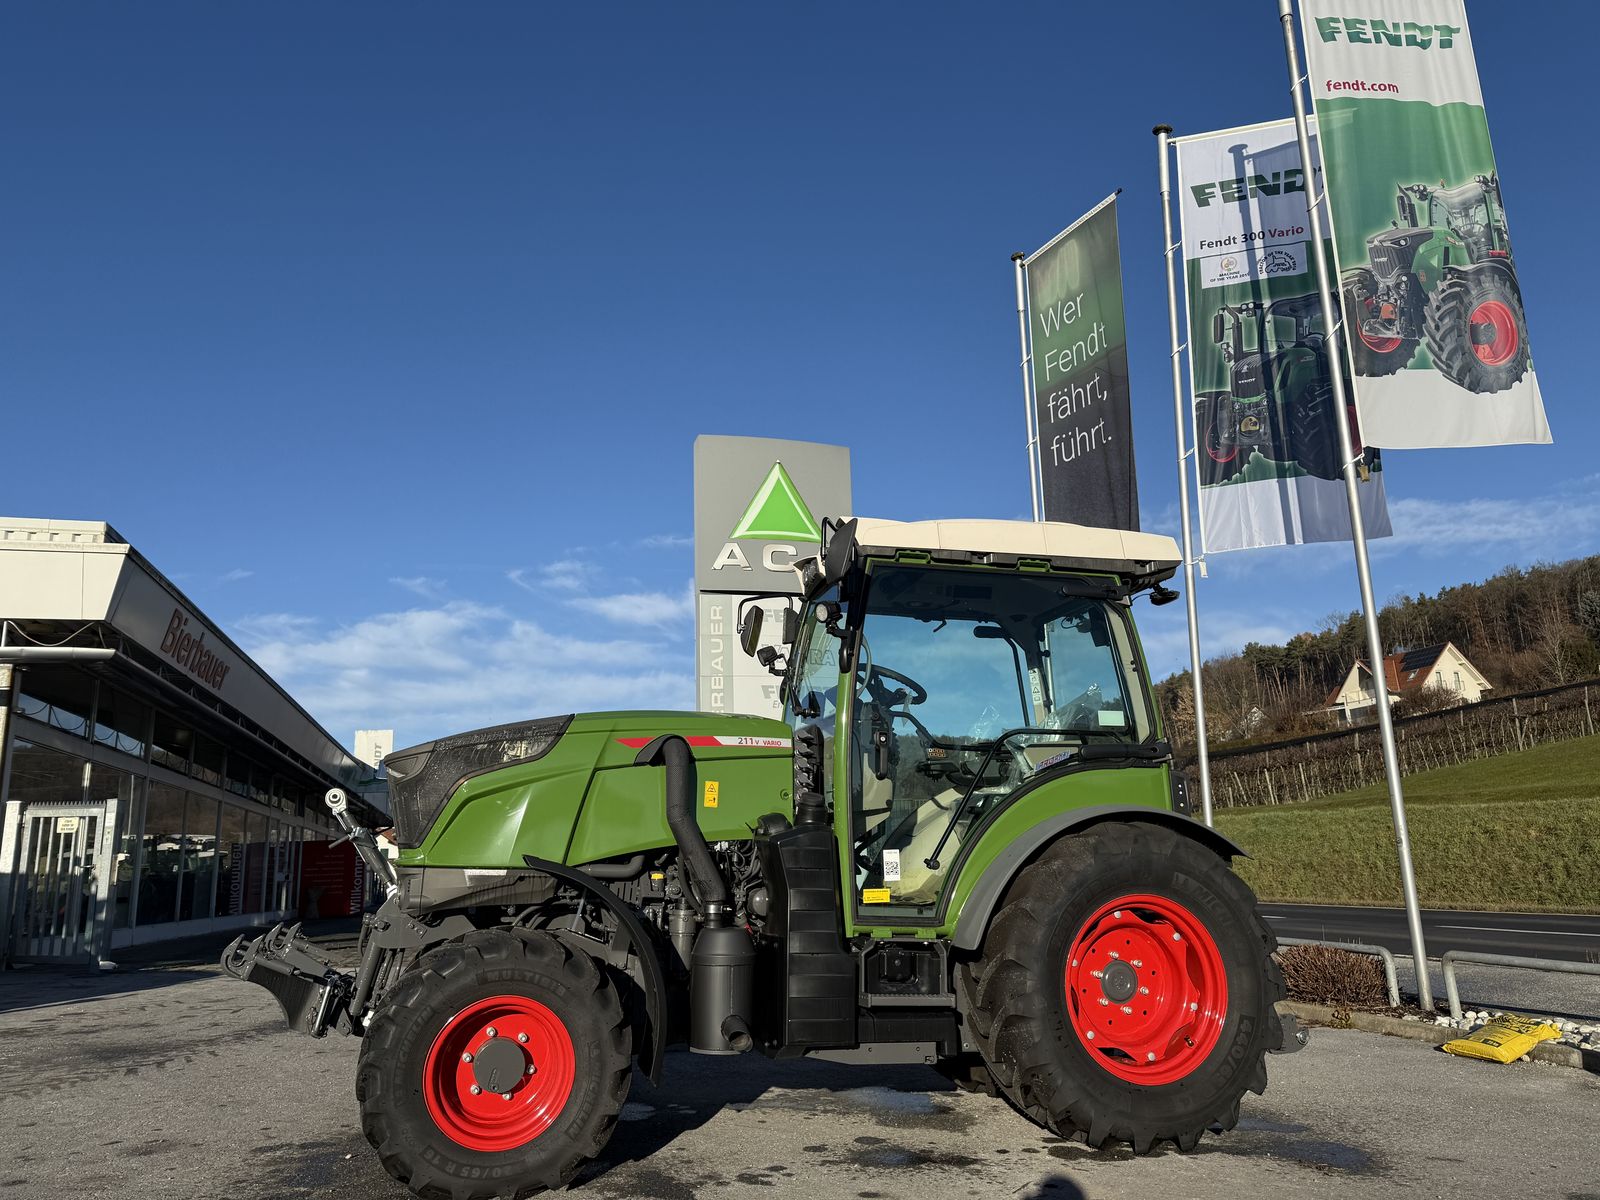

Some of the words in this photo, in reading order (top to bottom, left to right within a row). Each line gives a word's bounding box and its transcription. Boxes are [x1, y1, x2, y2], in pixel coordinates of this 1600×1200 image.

[1315, 17, 1461, 50] FENDT
[1326, 80, 1399, 93] fendt.com
[1190, 166, 1325, 208] FEND
[1200, 236, 1237, 250] Fendt
[1241, 230, 1265, 242] 300
[1268, 226, 1304, 238] Vario
[1039, 293, 1084, 338] Wer
[1044, 322, 1107, 381] Fendt
[1047, 373, 1107, 423] fährt,
[1050, 418, 1112, 466] führt.
[160, 608, 230, 690] Bierbauer
[349, 854, 363, 914] Willkomm
